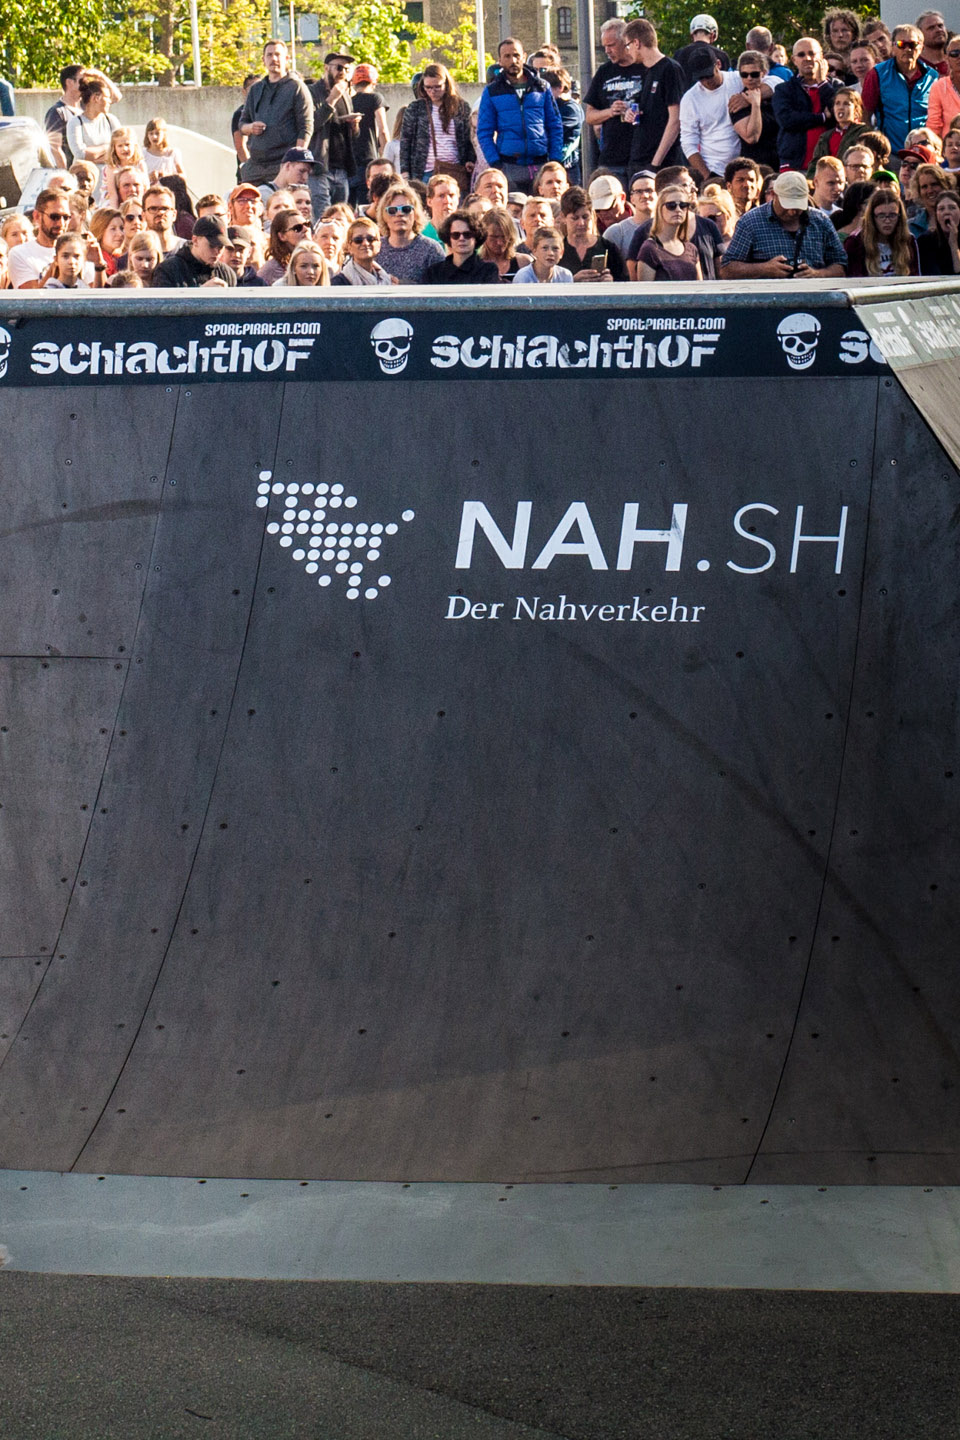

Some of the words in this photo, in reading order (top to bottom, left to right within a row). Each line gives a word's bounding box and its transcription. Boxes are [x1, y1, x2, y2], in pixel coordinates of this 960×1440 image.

[454, 500, 849, 575] NAH.SH
[444, 595, 504, 620] Der
[512, 594, 706, 623] Nahverkehr
